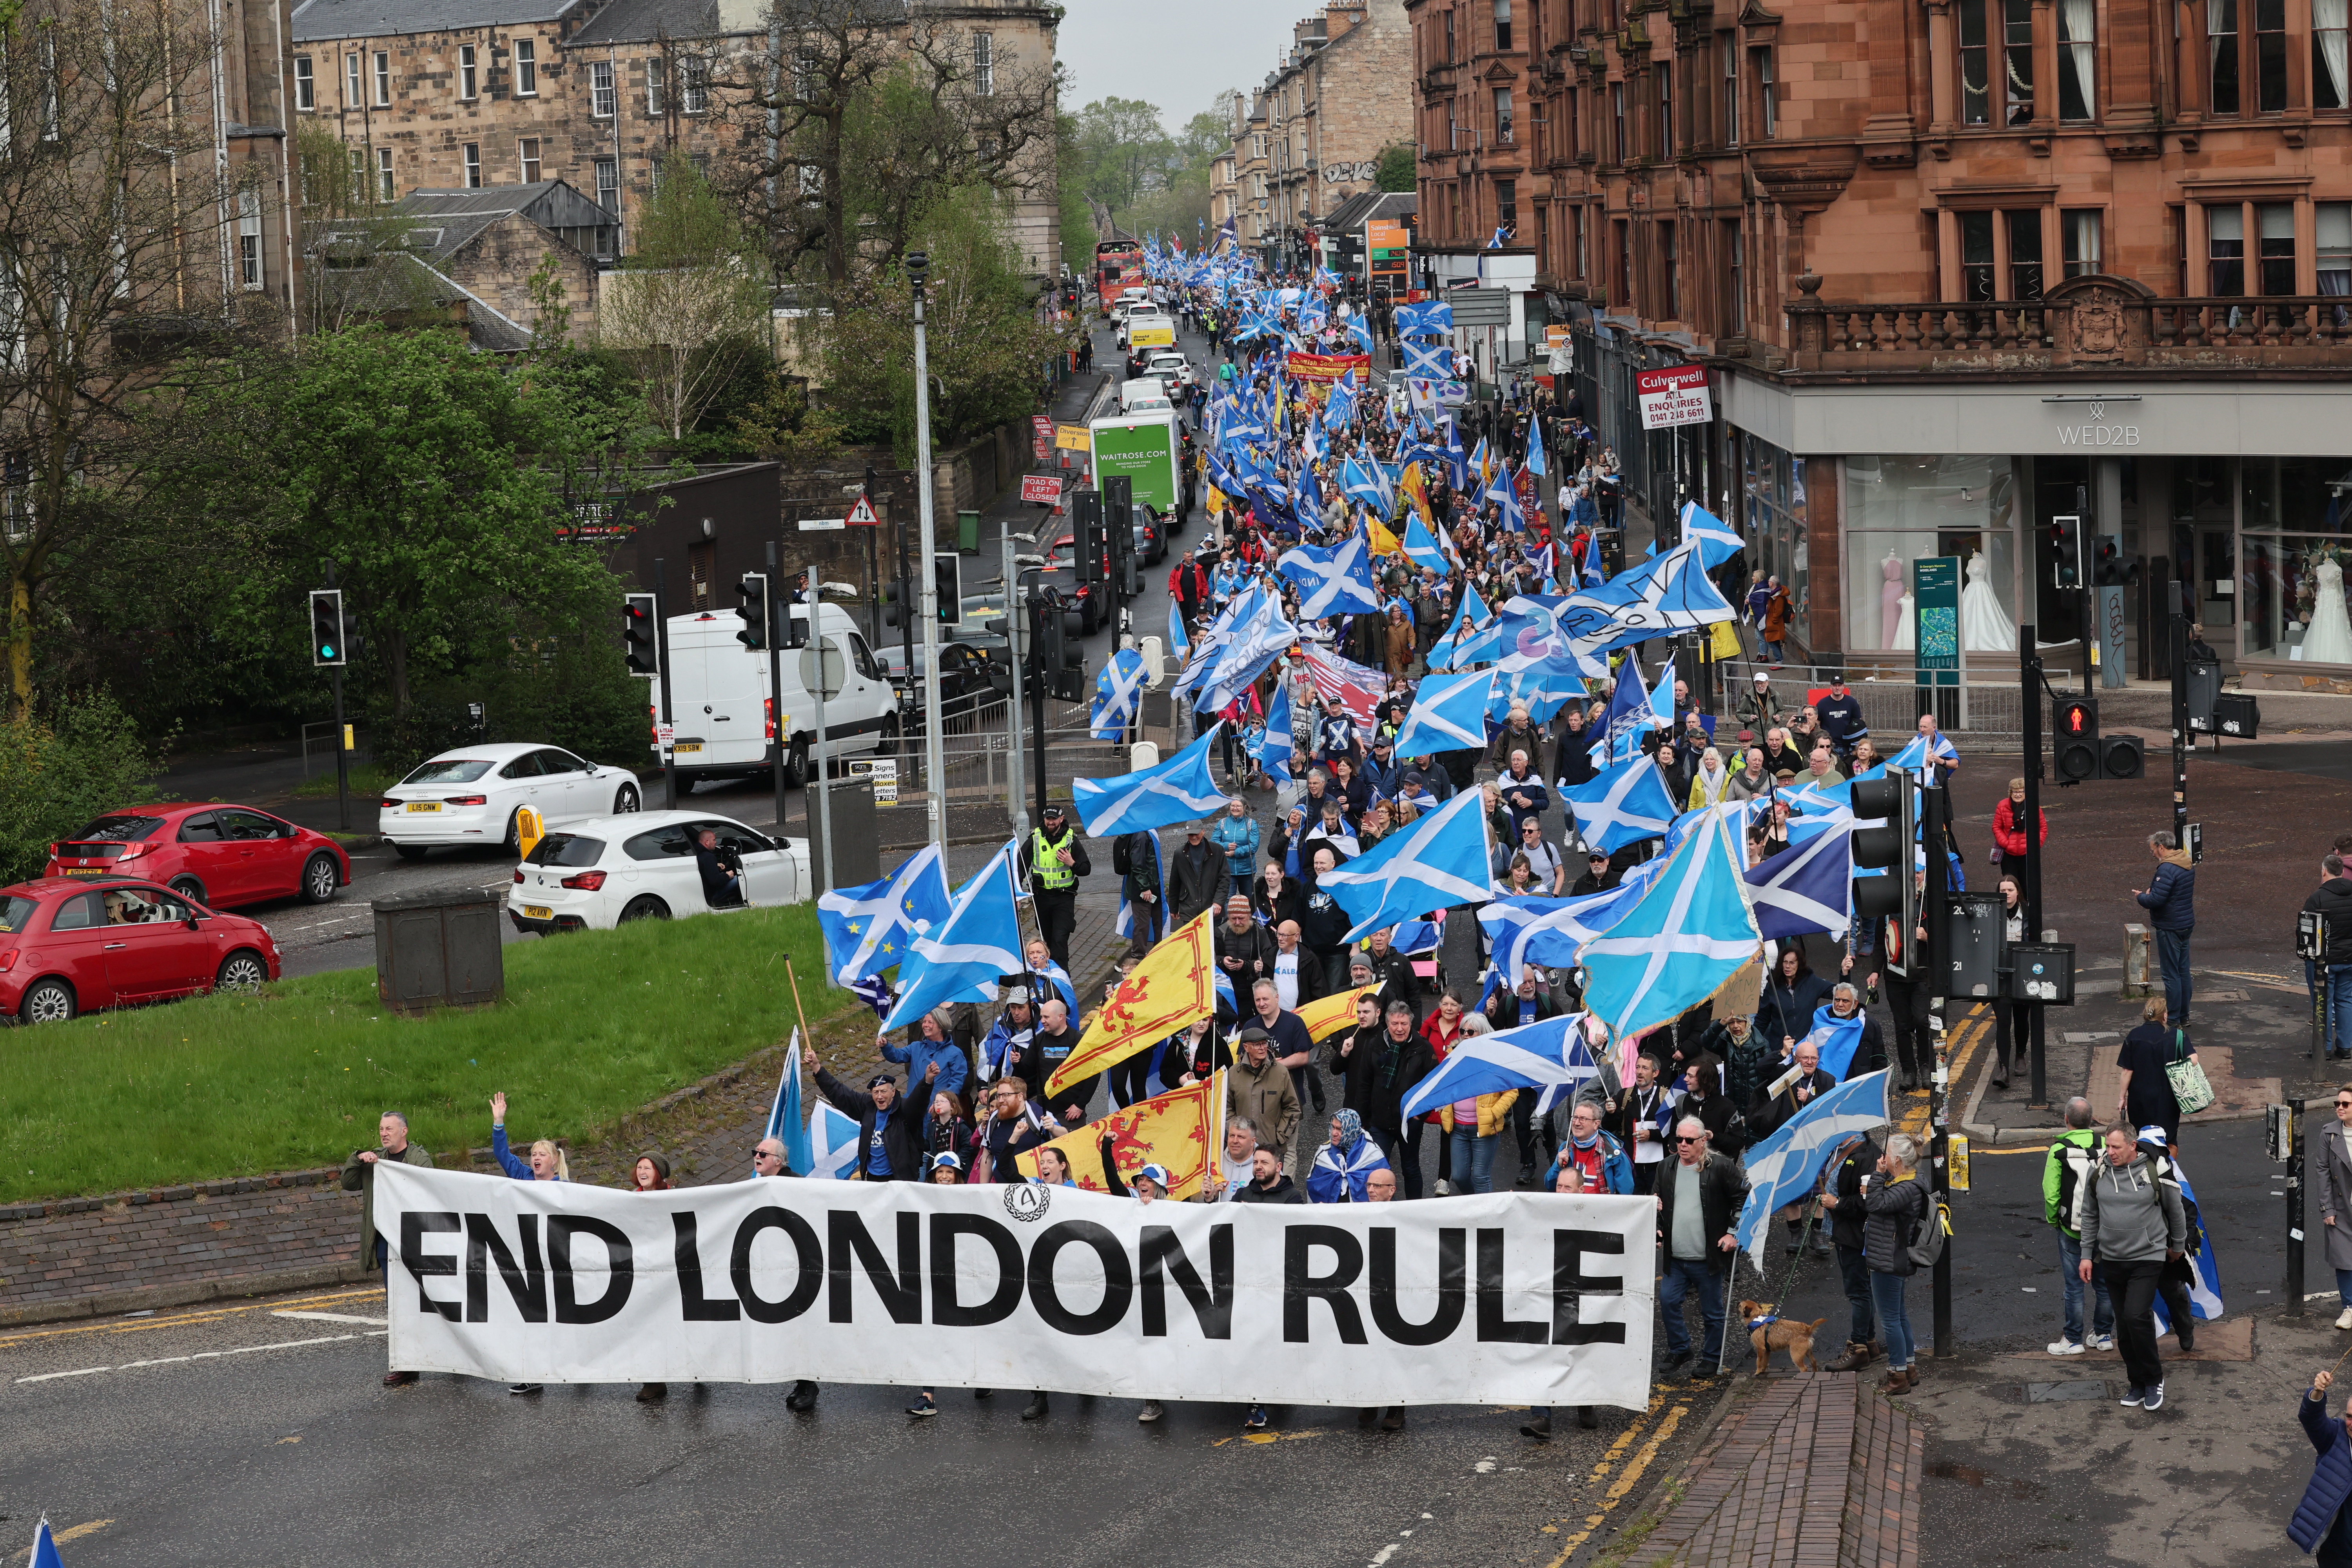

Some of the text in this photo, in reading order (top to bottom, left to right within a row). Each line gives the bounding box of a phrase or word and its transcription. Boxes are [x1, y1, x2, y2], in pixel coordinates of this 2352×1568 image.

[1291, 357, 1317, 367] Scottish
[1290, 365, 1316, 374] Glasgow
[1641, 370, 1703, 388] Culverwell
[1648, 398, 1702, 412] ENQUIRIES
[1650, 412, 1667, 423] 0141
[1687, 408, 1704, 418] 6611
[1060, 428, 1091, 437] Diversion
[2057, 426, 2140, 446] WED2B
[1100, 450, 1167, 461] WAITROSE.COM
[1026, 493, 1056, 501] CLOSED
[537, 908, 547, 917] AKN
[1953, 961, 1962, 970] 21
[1726, 977, 1760, 993] NOT MY
[1724, 994, 1755, 1009] KING
[399, 1206, 1626, 1347] END LONDON RULE
